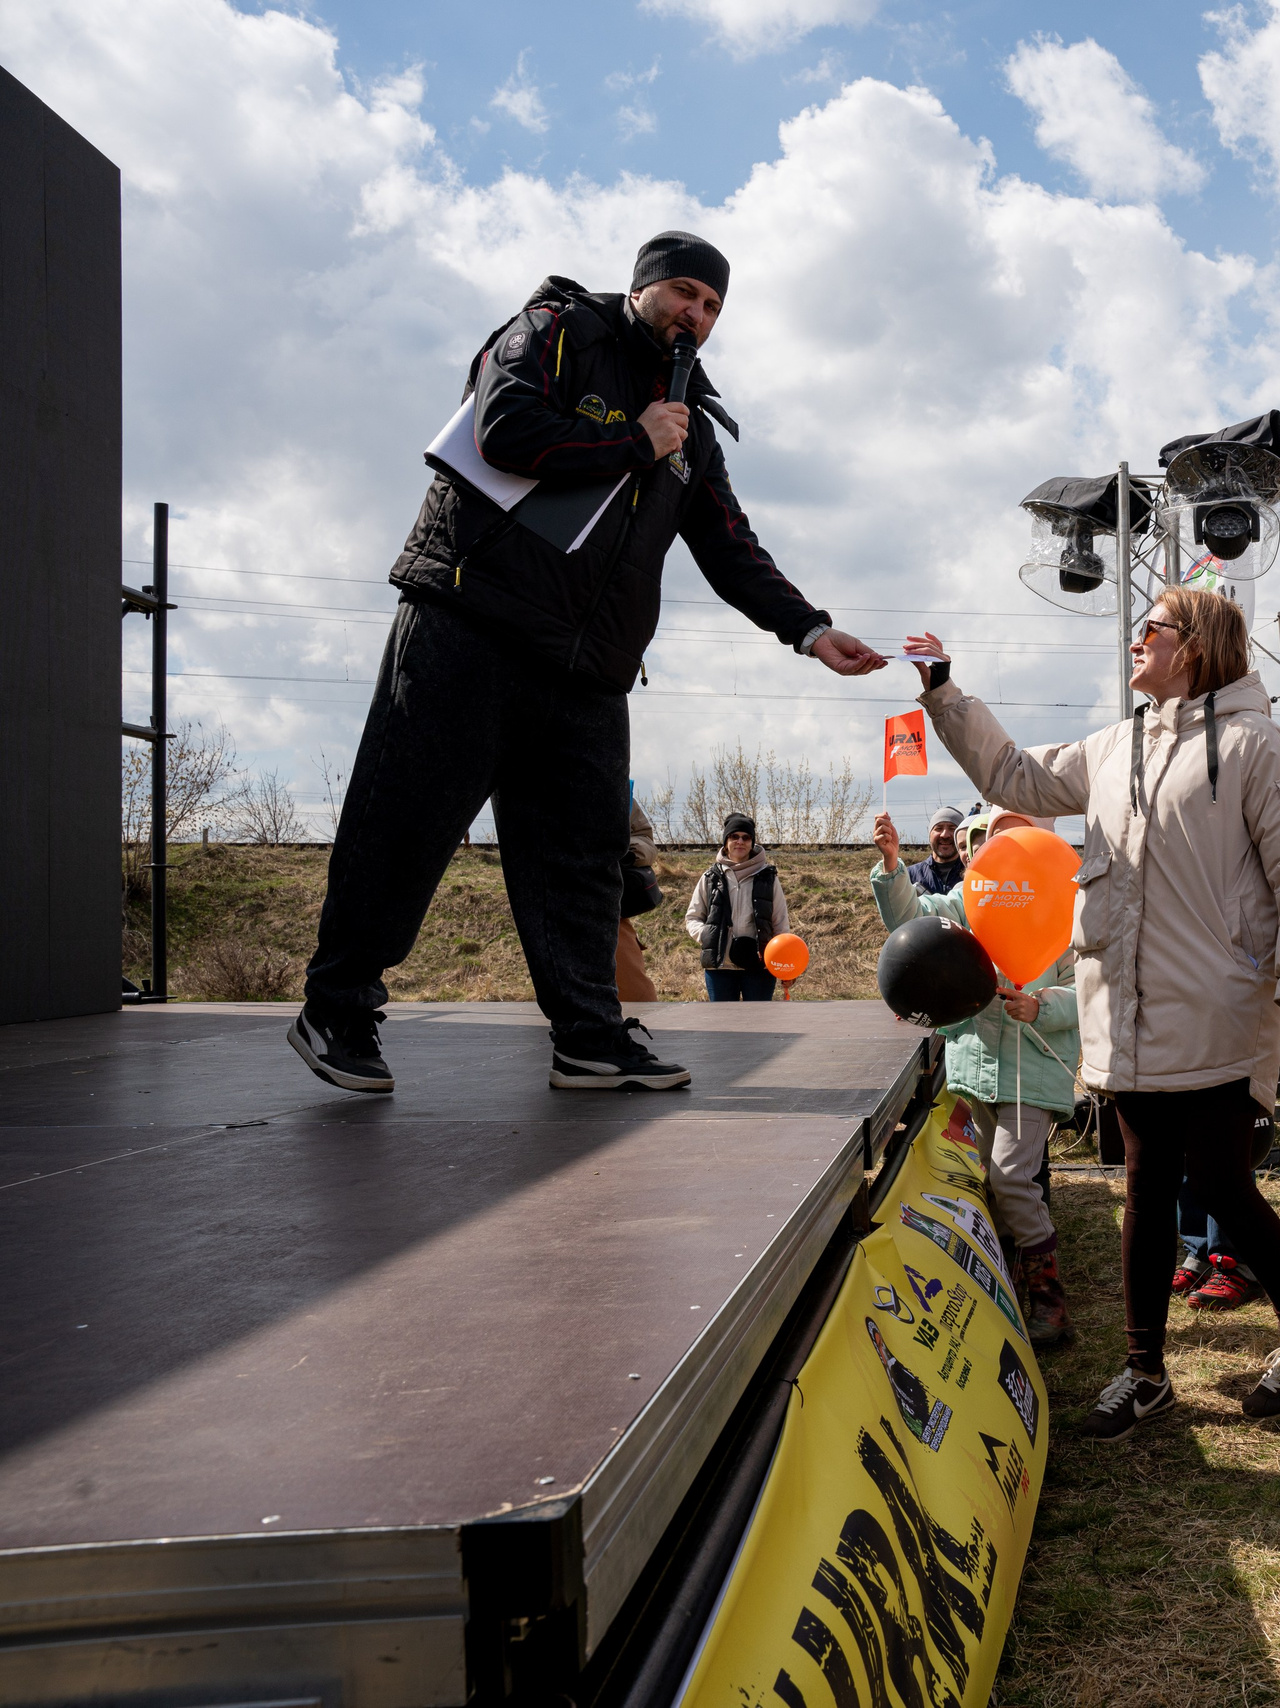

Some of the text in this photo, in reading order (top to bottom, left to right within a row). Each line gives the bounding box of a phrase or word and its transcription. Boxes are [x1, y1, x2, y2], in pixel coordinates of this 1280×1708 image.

[889, 731, 922, 746] URAL
[971, 879, 1035, 893] URAL
[913, 1318, 940, 1351] УАЗ
[936, 1348, 958, 1382] Автоцентр
[955, 1364, 970, 1390] Косарева
